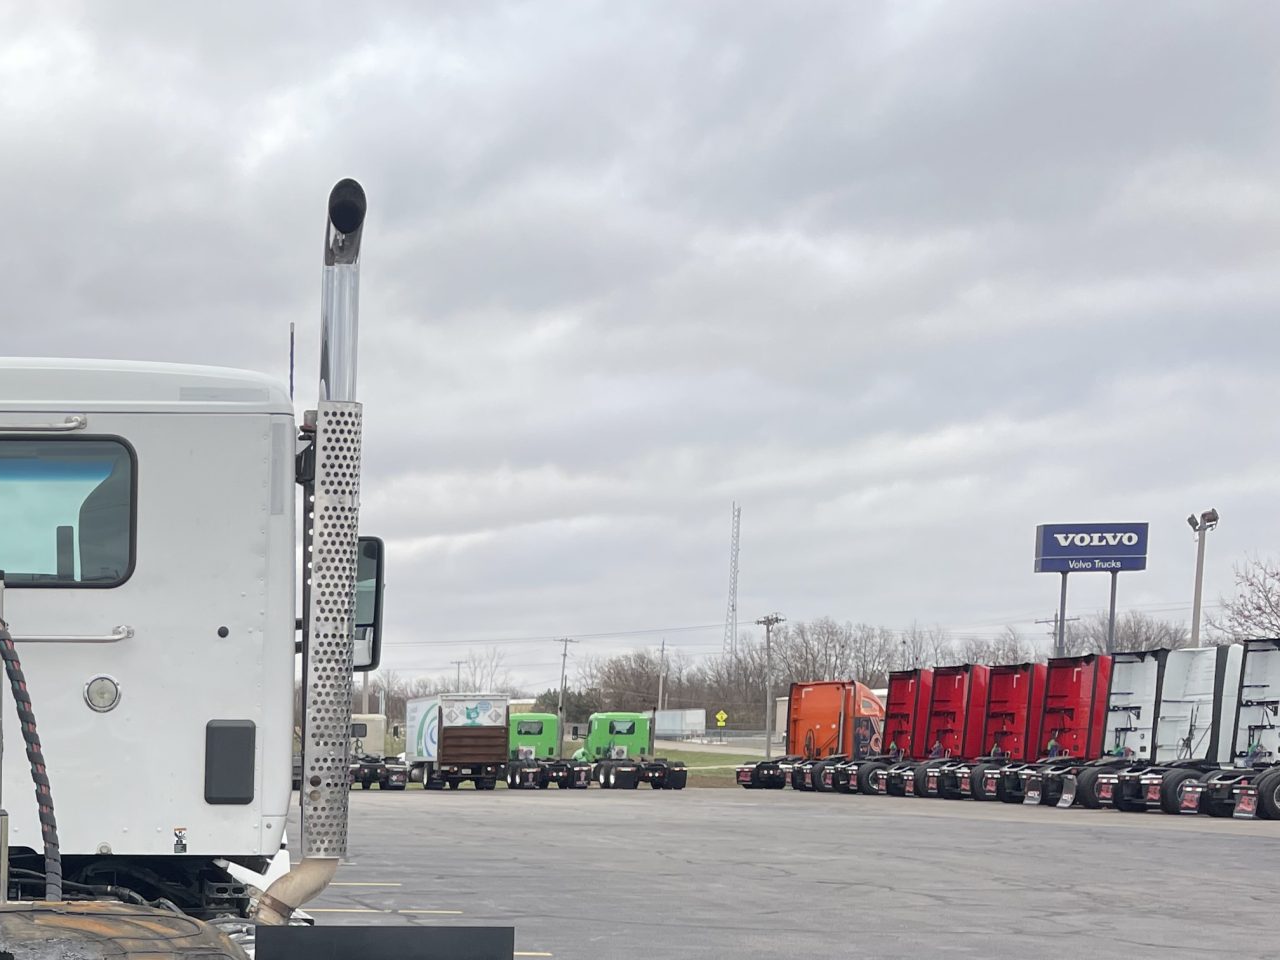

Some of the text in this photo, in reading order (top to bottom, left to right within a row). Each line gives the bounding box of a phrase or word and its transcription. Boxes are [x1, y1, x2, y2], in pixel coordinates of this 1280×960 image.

[1054, 532, 1139, 547] VOLVO
[1069, 559, 1122, 569] Volvo Trucks
